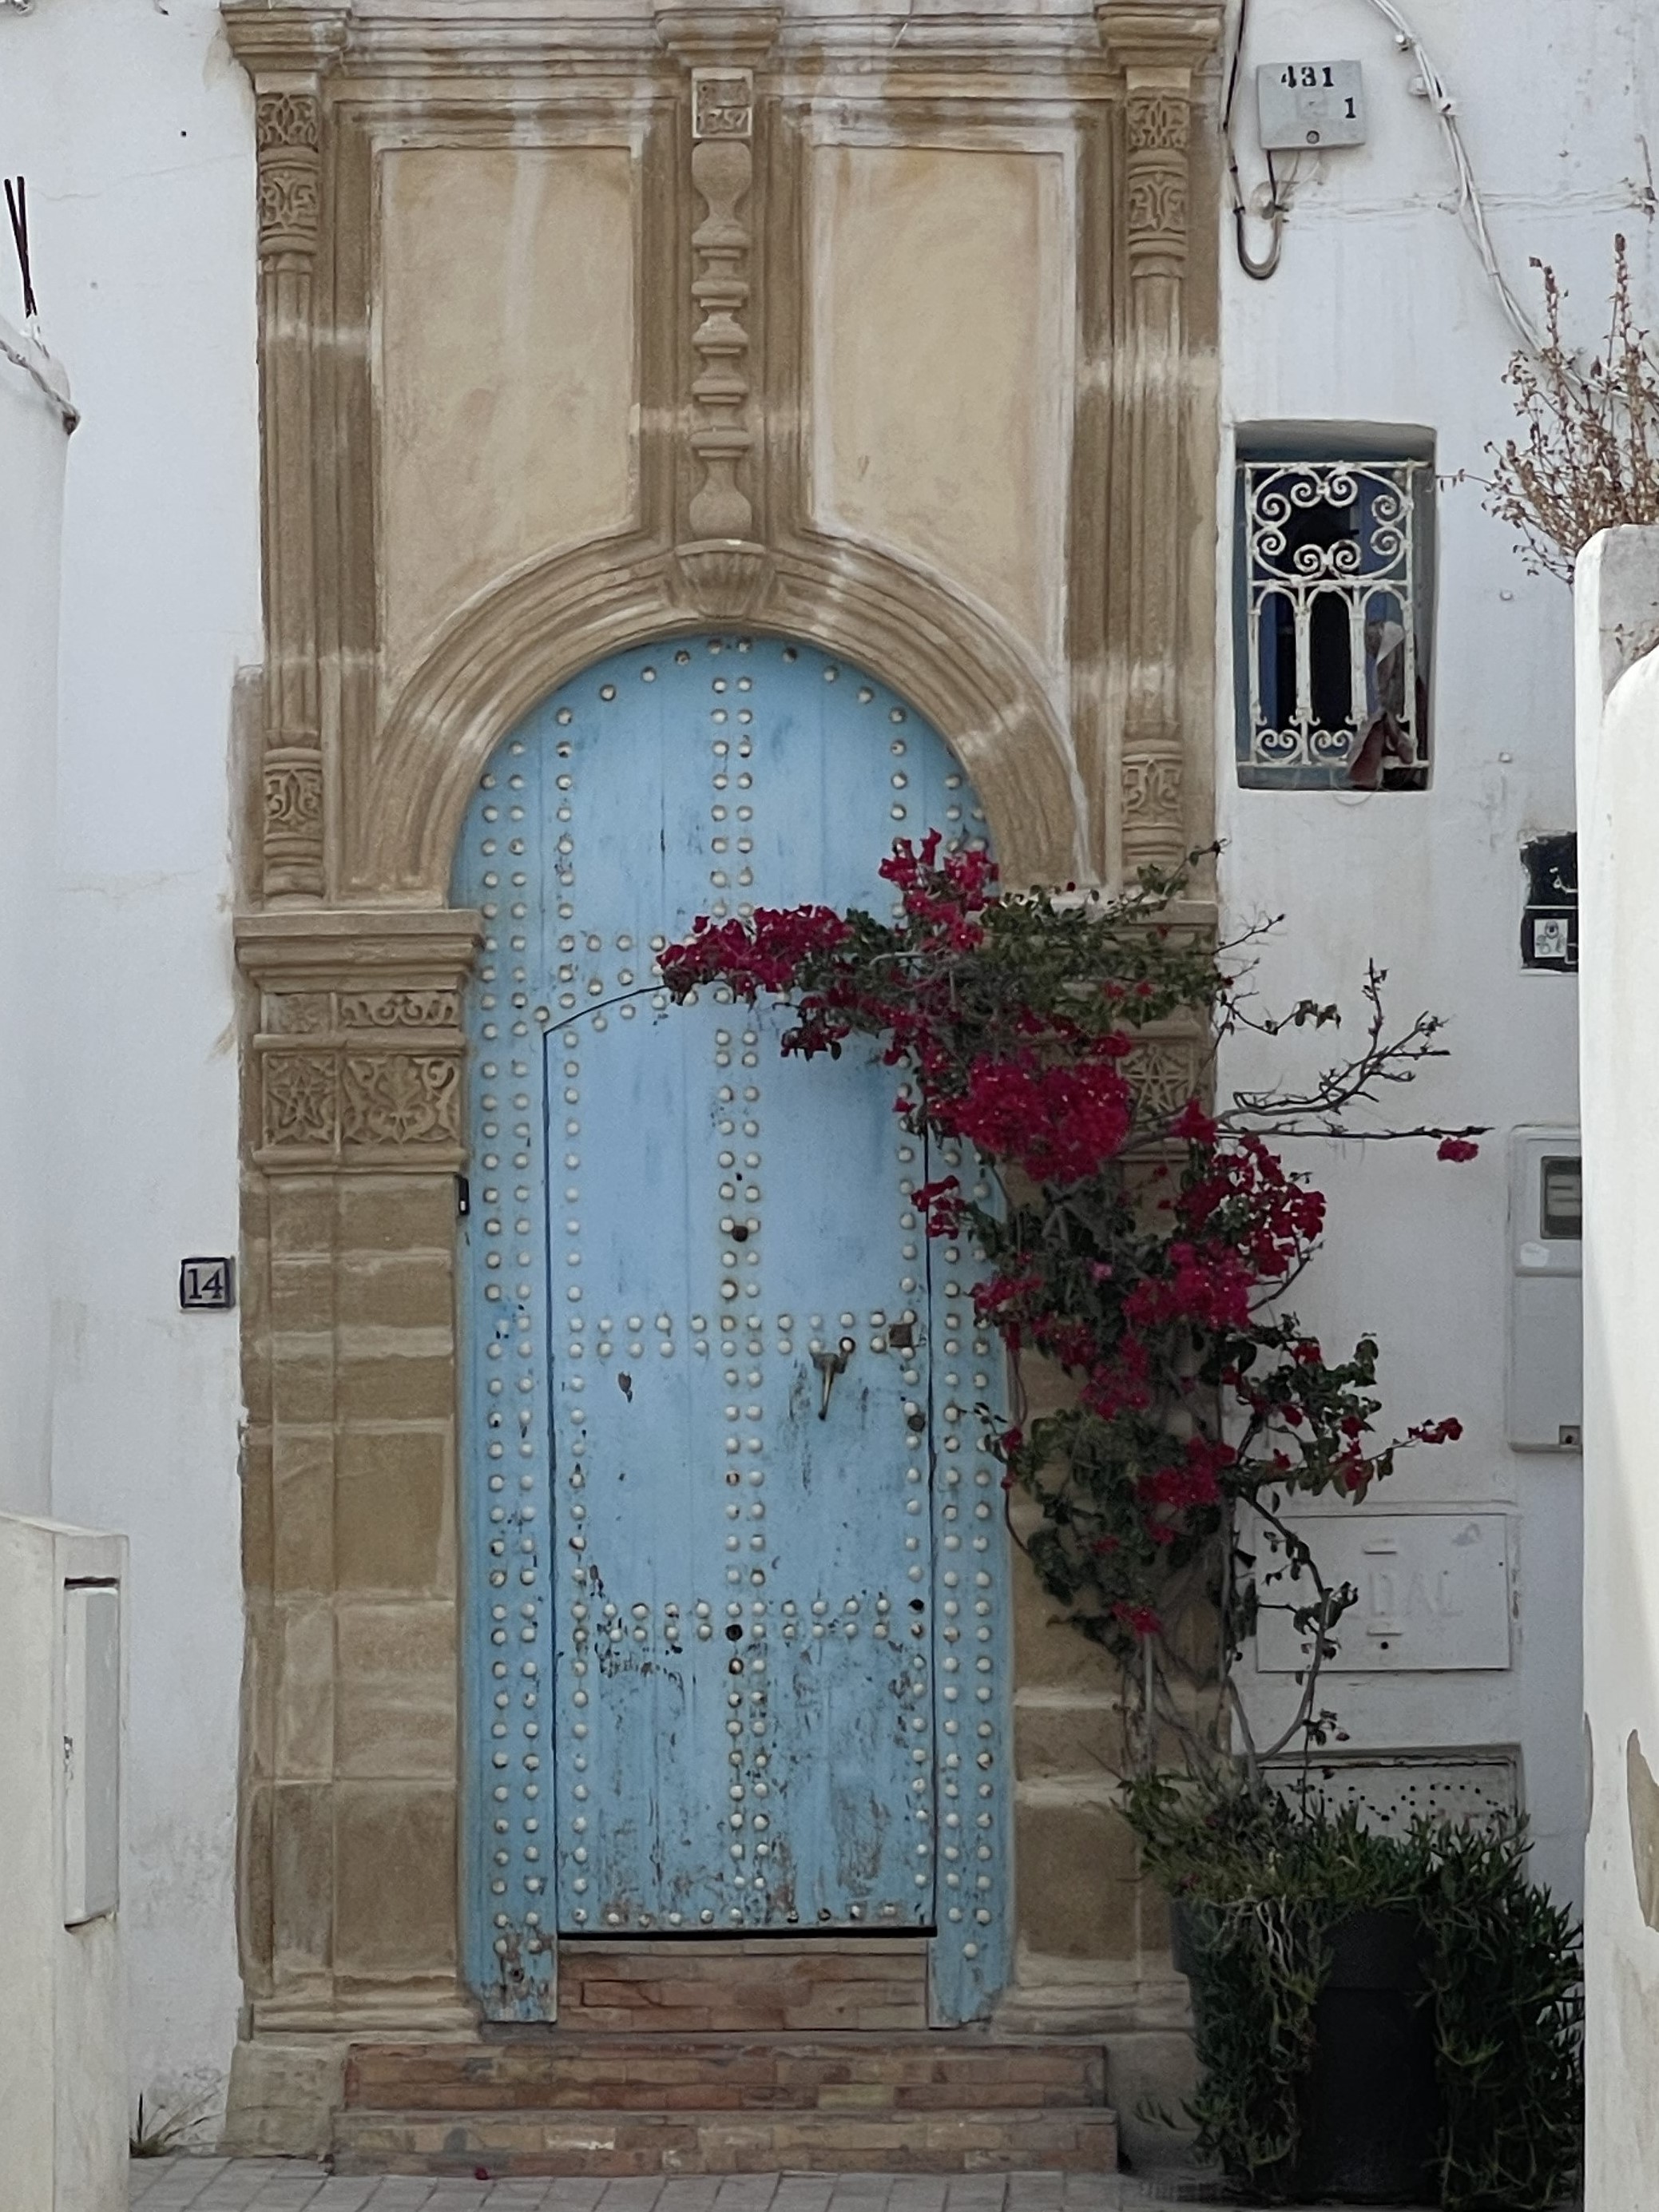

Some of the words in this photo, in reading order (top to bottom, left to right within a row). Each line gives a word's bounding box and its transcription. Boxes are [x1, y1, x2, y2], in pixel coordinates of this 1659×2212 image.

[1280, 66, 1334, 89] 431
[1344, 97, 1357, 119] 1
[187, 1268, 224, 1300] 14
